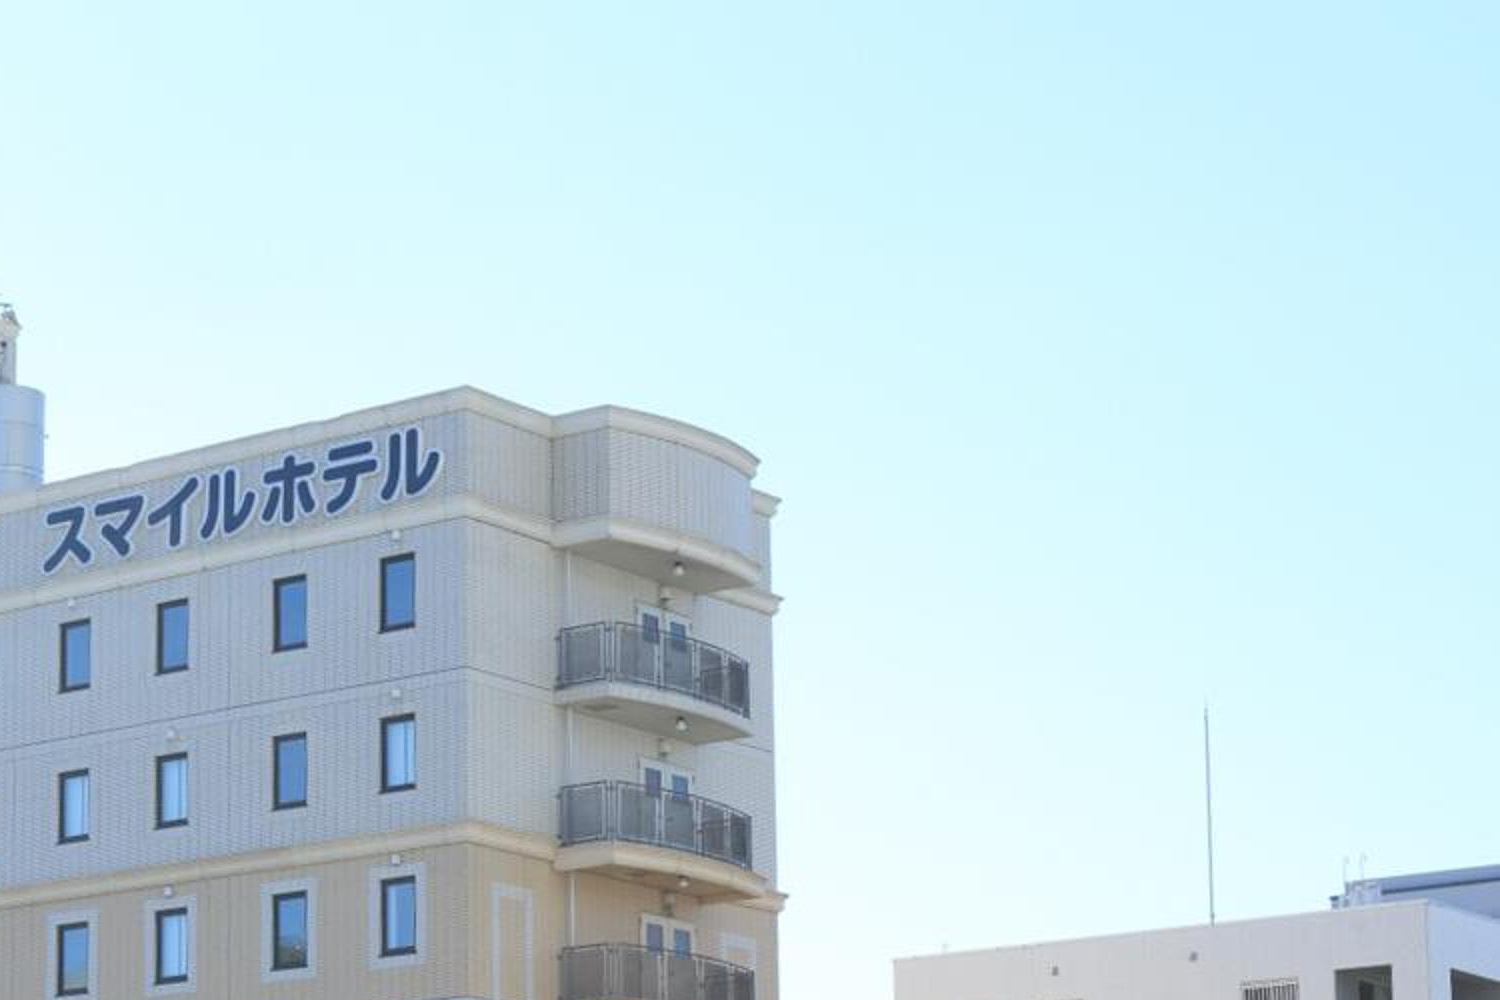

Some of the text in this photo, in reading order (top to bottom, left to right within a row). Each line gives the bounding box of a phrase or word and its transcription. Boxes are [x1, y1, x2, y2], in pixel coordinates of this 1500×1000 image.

[43, 428, 440, 573] スマイルホテル
